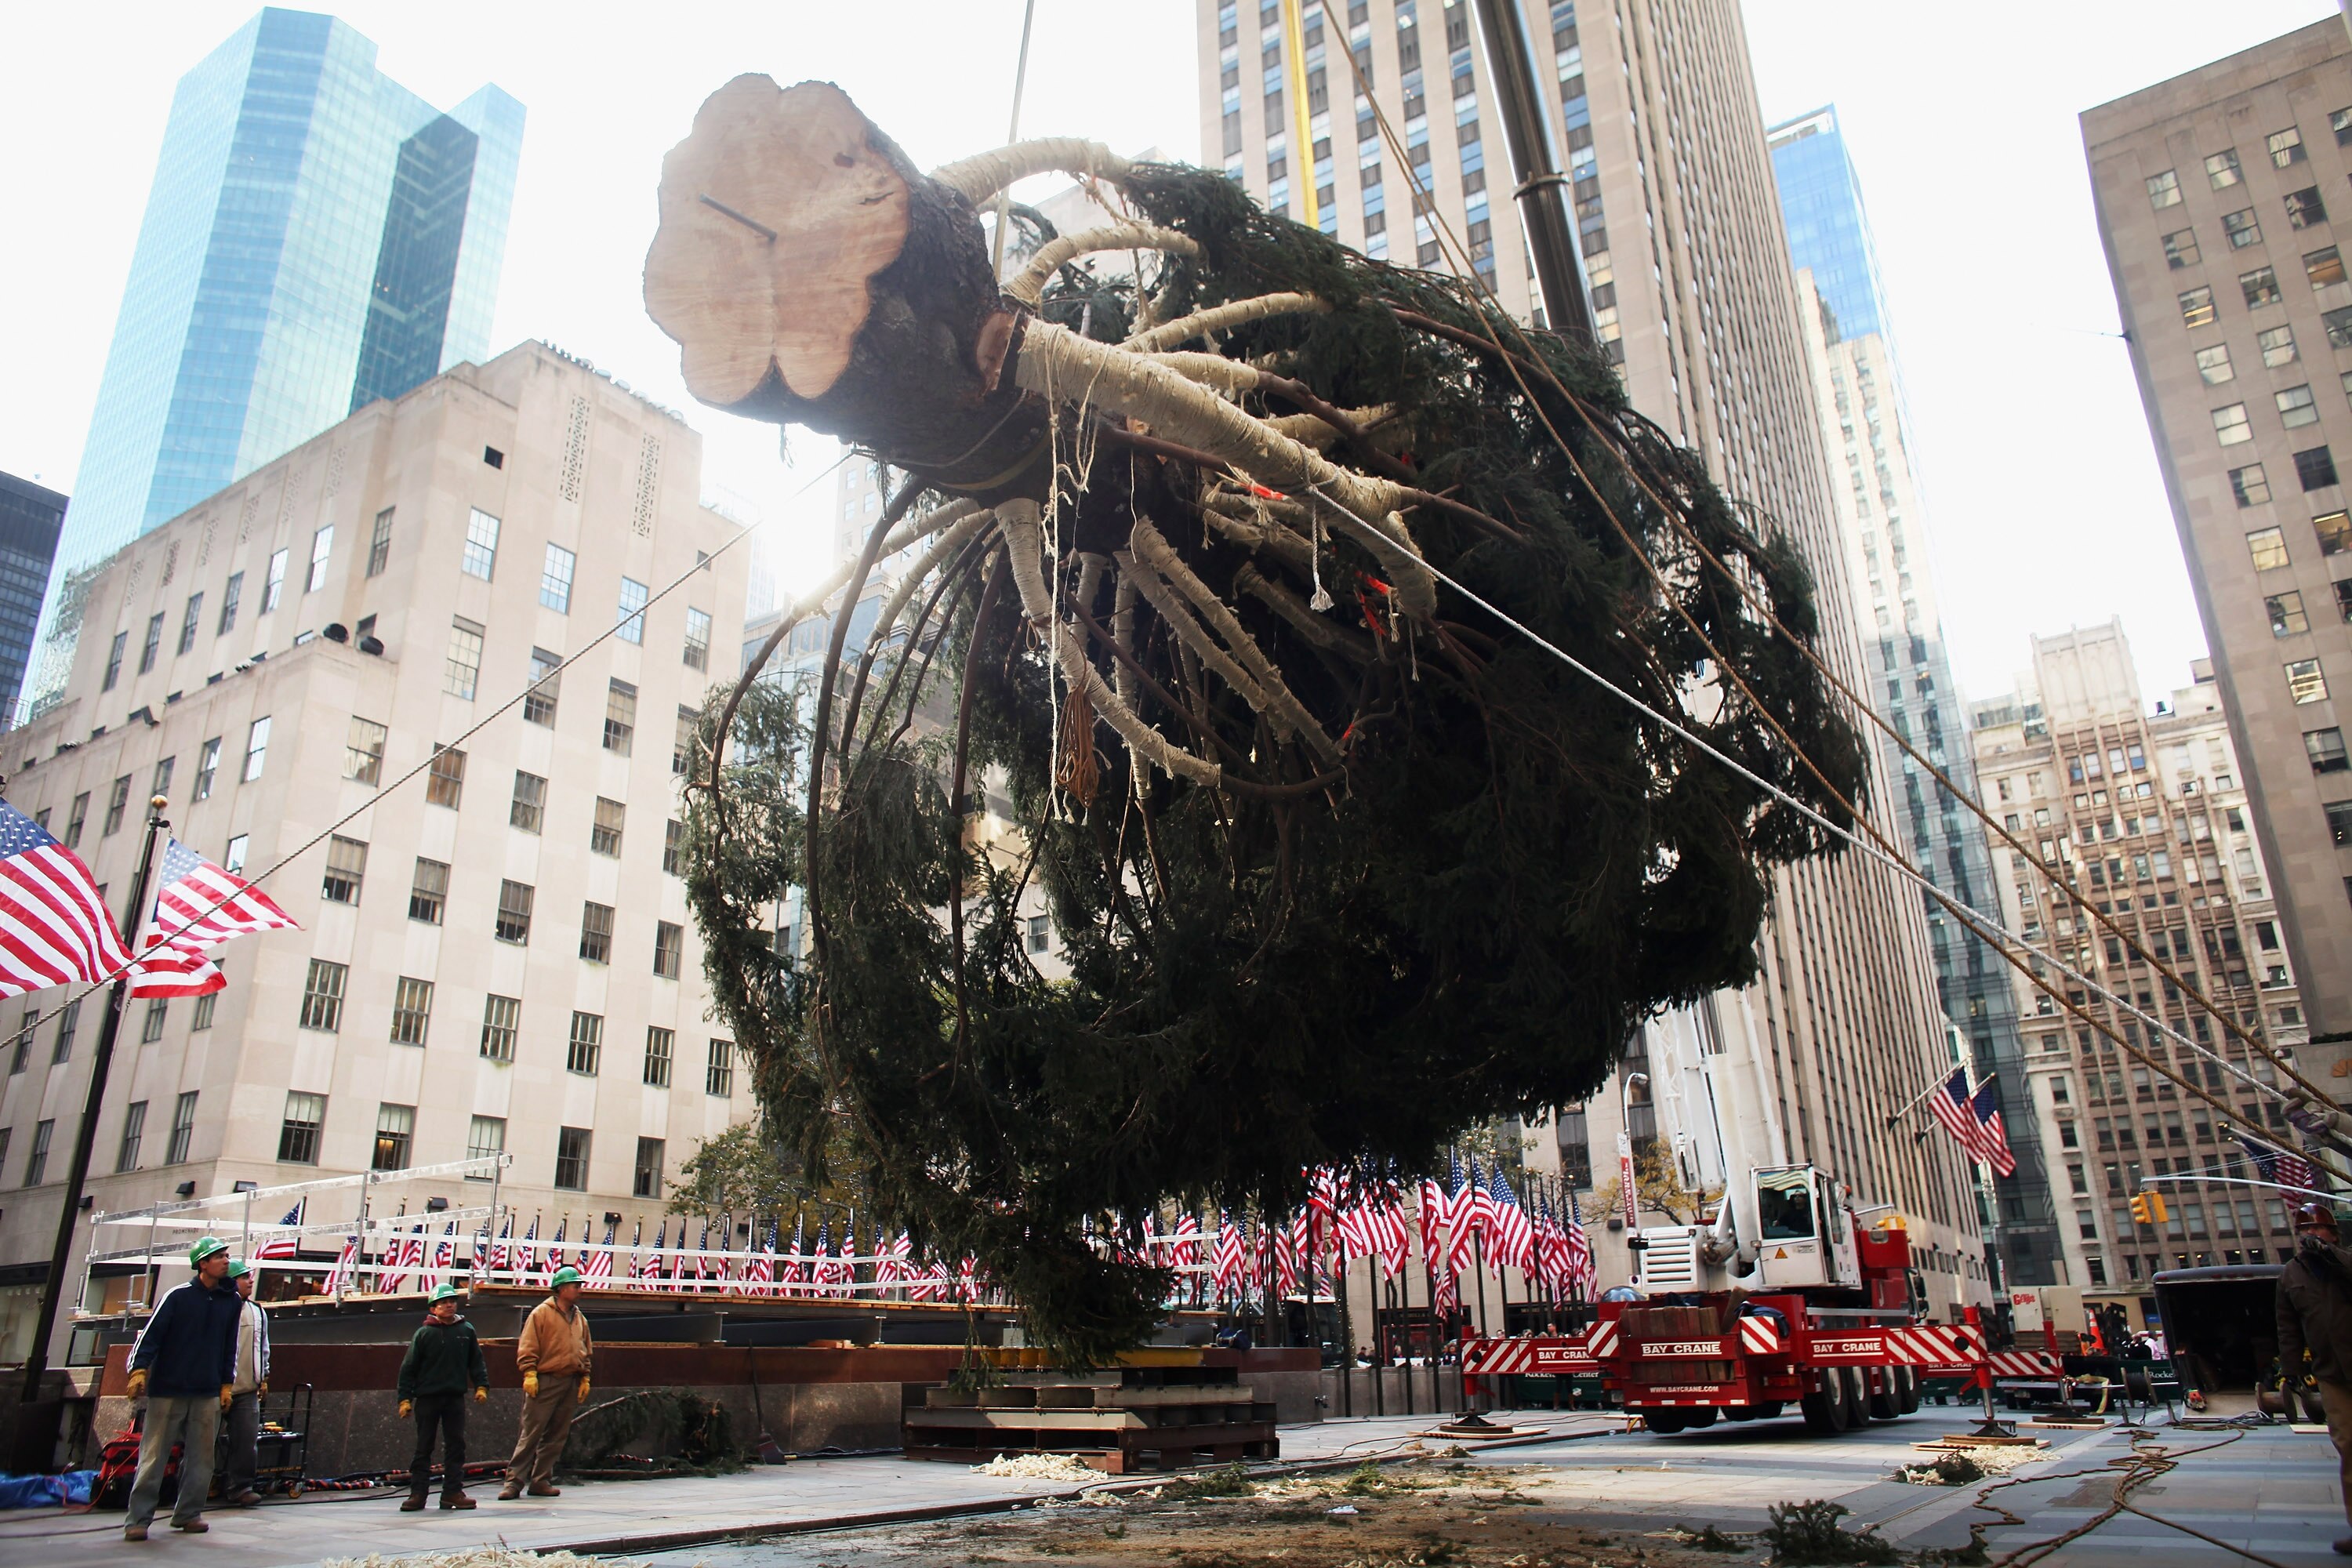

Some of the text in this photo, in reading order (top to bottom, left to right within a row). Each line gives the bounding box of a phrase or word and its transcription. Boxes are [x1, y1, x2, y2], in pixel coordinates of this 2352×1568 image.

[1642, 1344, 1721, 1354] BAY CRANE
[1813, 1342, 1882, 1353] BAY CRANE
[1538, 1351, 1556, 1359] BAY
